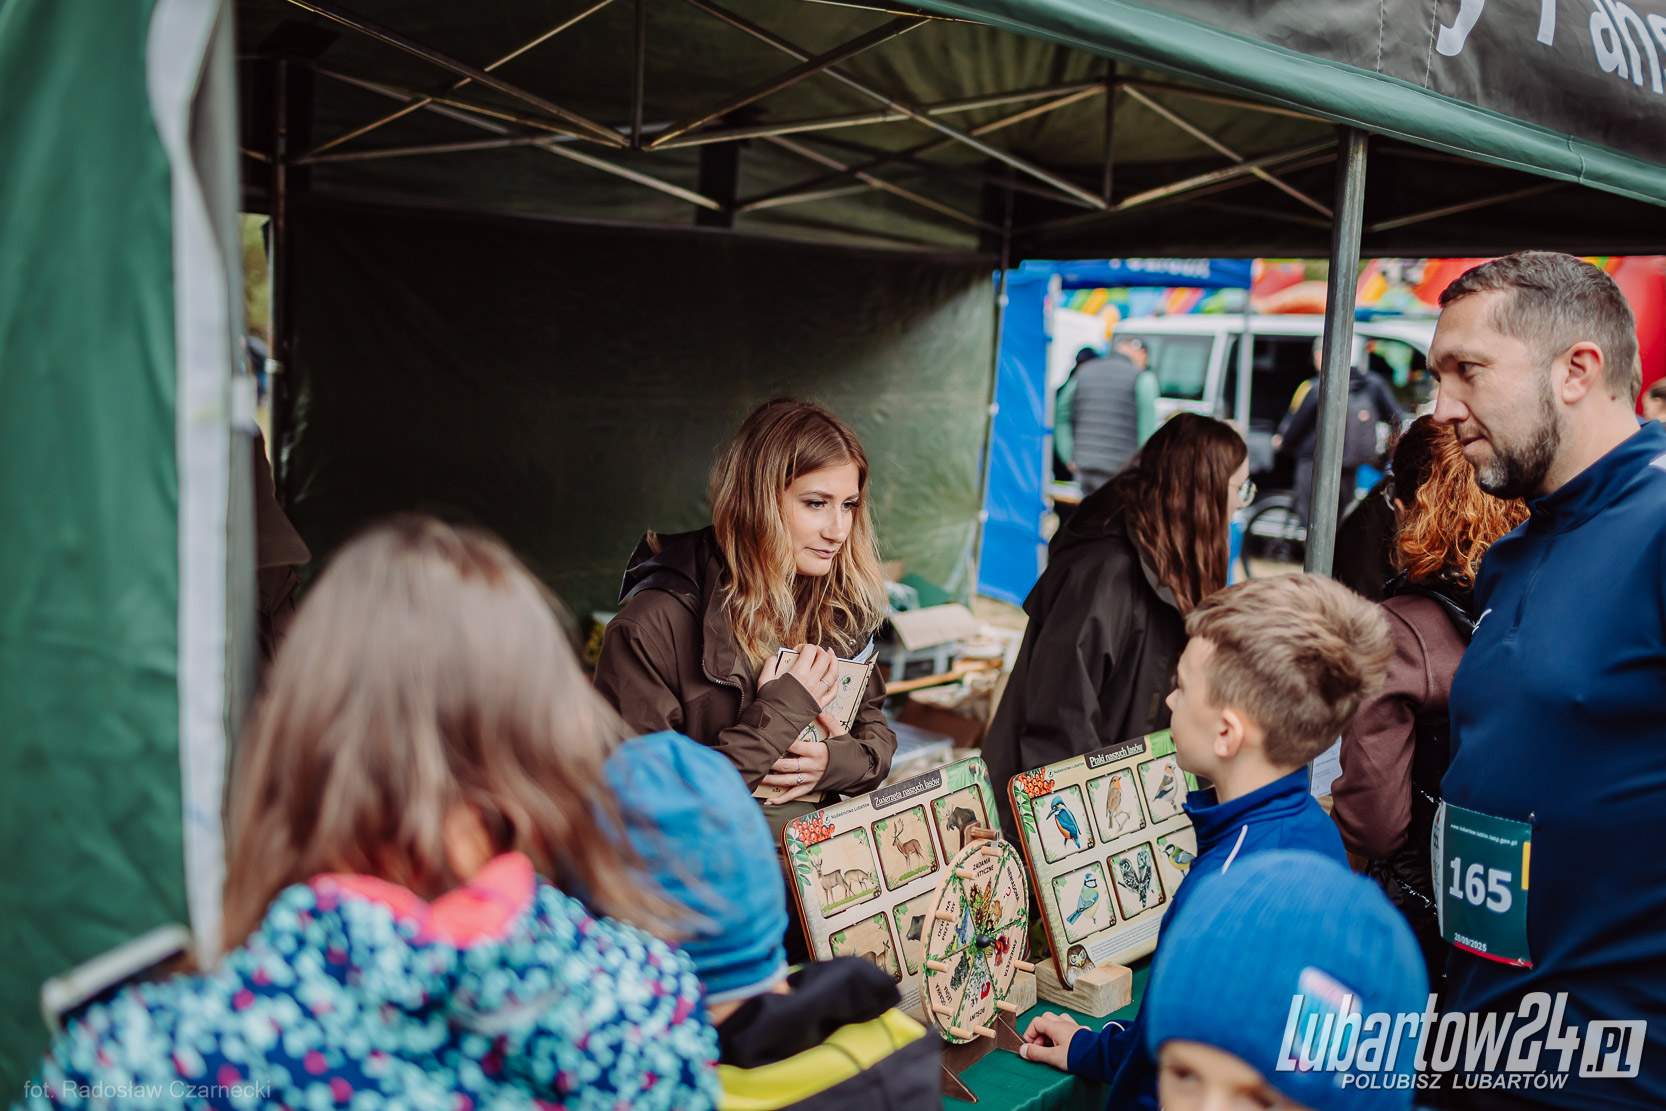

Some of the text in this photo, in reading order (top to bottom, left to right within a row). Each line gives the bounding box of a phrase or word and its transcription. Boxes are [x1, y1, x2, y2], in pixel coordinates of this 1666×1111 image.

[1089, 754, 1105, 768] Ptaki
[1105, 747, 1127, 762] naszych
[1127, 743, 1144, 756] lasów
[873, 777, 940, 808] Zwierzęta naszych lasów
[1449, 856, 1512, 914] 165
